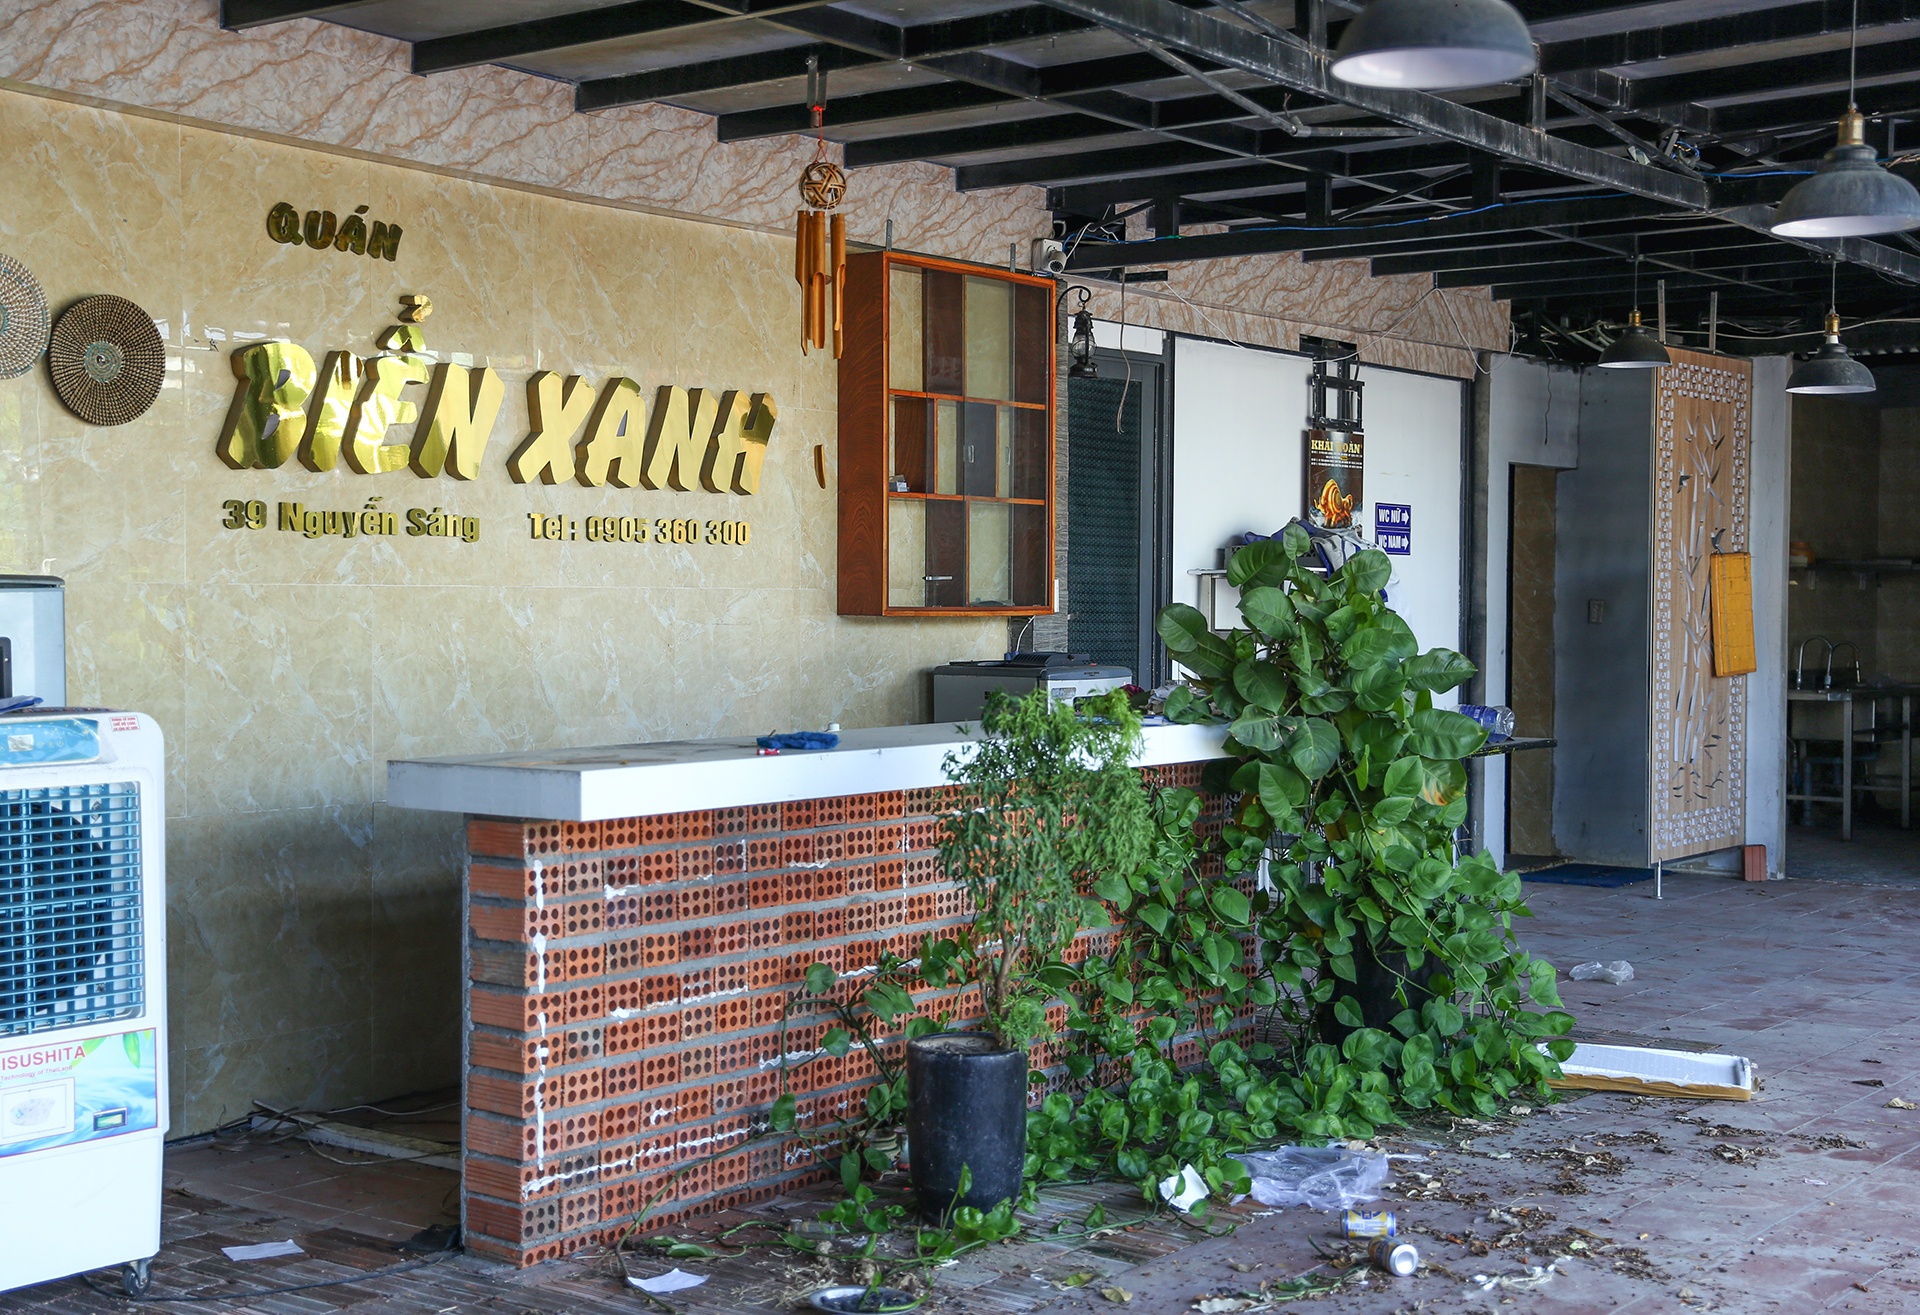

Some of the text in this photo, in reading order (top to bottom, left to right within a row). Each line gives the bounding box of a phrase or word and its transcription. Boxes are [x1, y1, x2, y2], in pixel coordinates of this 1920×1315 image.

[267, 201, 403, 261] QUÁN
[216, 294, 777, 496] BIỂN XANH
[222, 499, 267, 530] 39
[278, 496, 399, 538] Nguyễn
[406, 507, 480, 543] Sáng
[586, 515, 651, 543] 0905
[655, 518, 700, 545] 360
[706, 520, 751, 546] 300
[1378, 507, 1401, 523] WC NỮ
[1388, 535, 1402, 549] NAM
[0, 1071, 36, 1081] Technology
